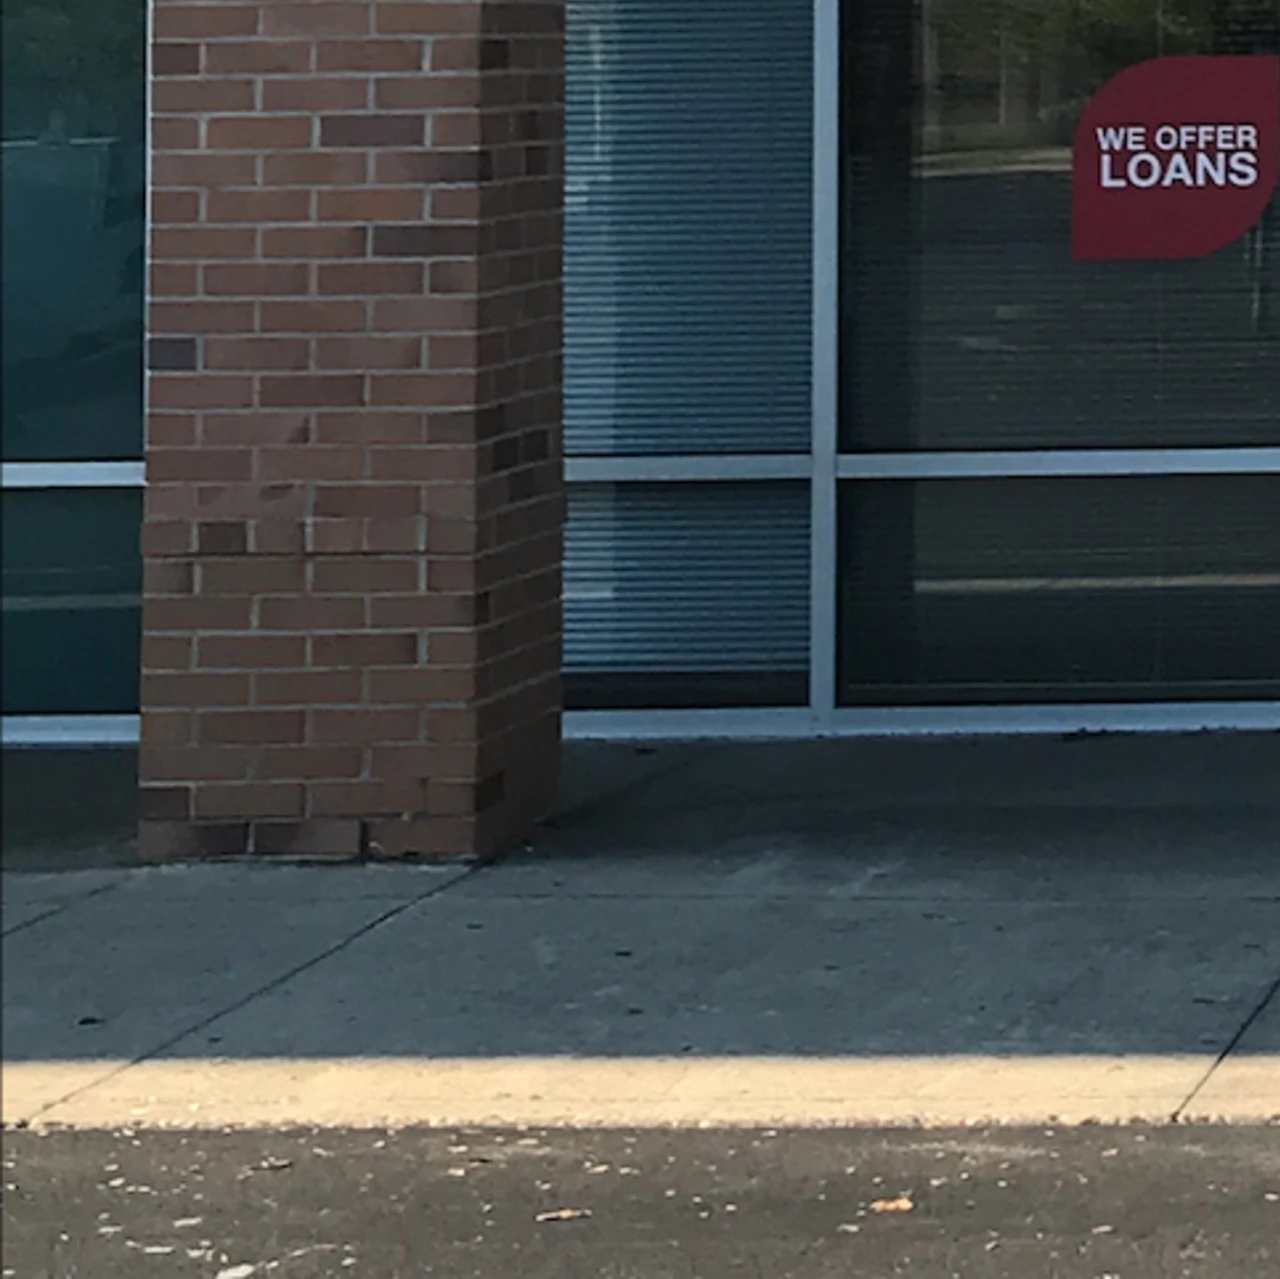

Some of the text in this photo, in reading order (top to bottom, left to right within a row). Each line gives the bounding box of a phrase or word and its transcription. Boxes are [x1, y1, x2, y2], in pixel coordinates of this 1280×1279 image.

[1097, 124, 1258, 150] WE OFFER
[1101, 152, 1258, 188] LOANS
